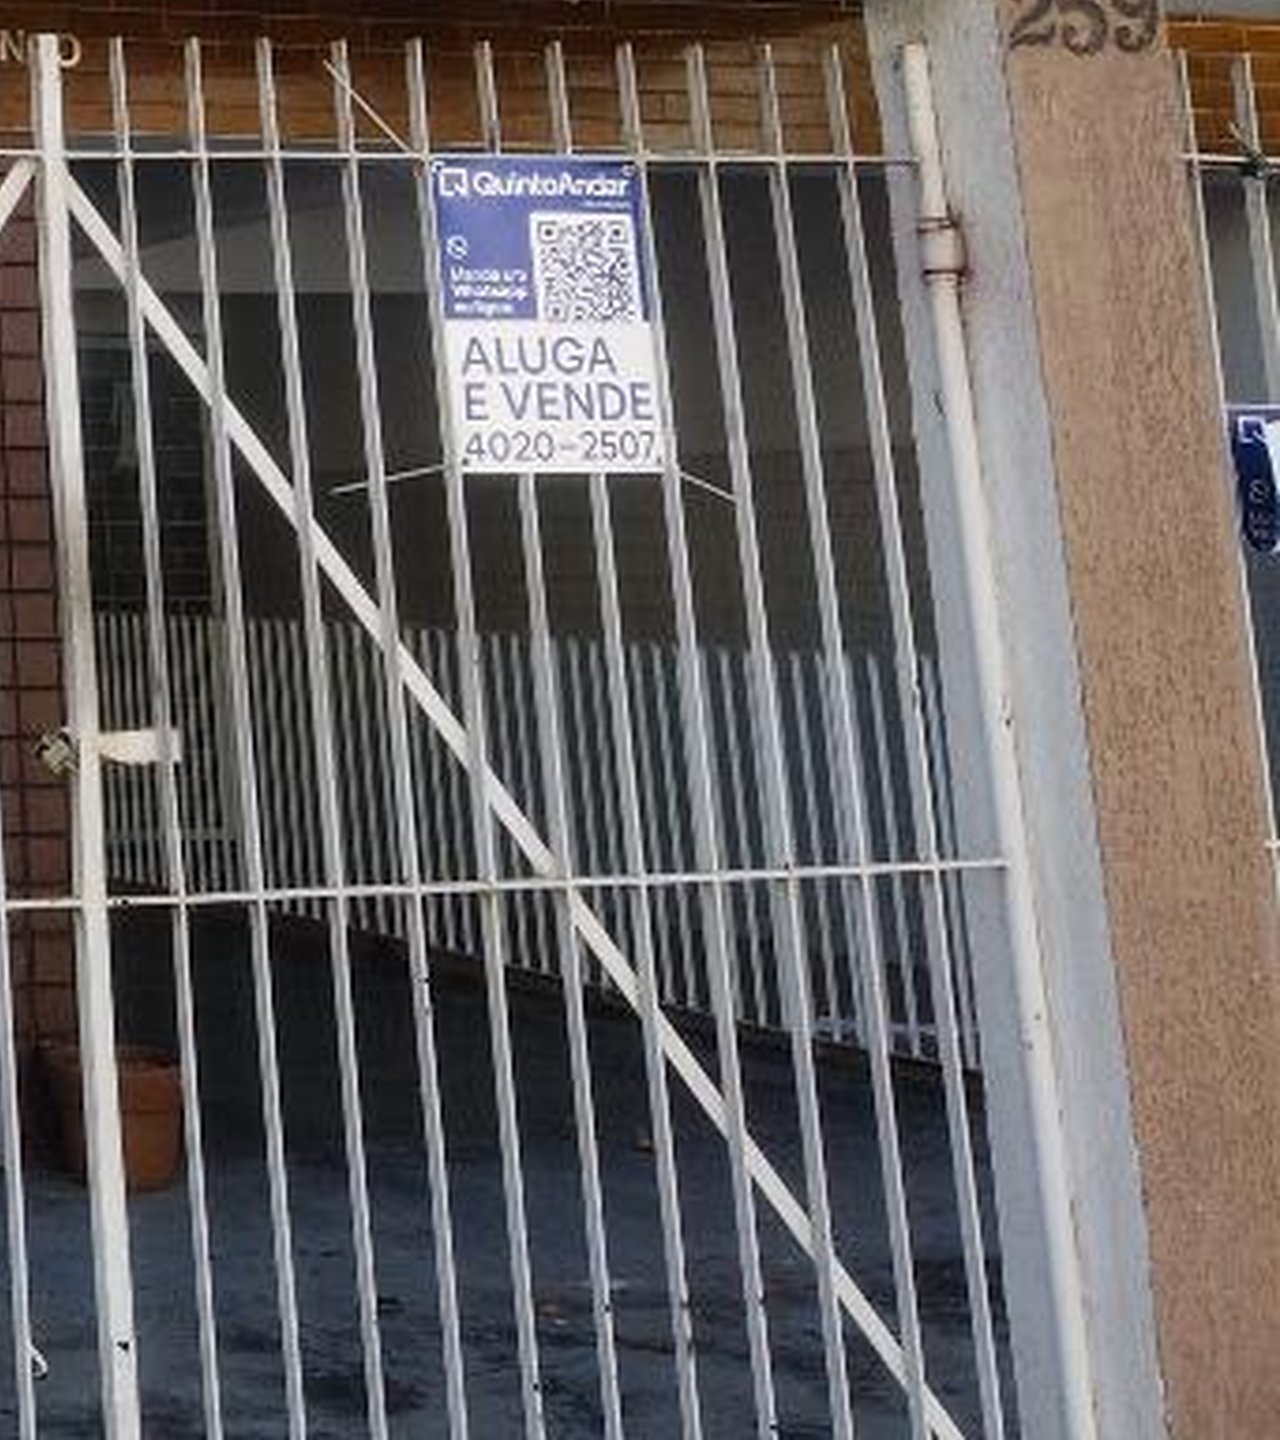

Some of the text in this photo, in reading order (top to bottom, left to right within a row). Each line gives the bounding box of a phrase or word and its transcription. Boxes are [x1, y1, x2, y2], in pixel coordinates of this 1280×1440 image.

[473, 171, 628, 198] QuintoAndar
[462, 336, 618, 375] ALUGA
[464, 381, 655, 421] E VENDE
[464, 430, 656, 462] 4020-2507
